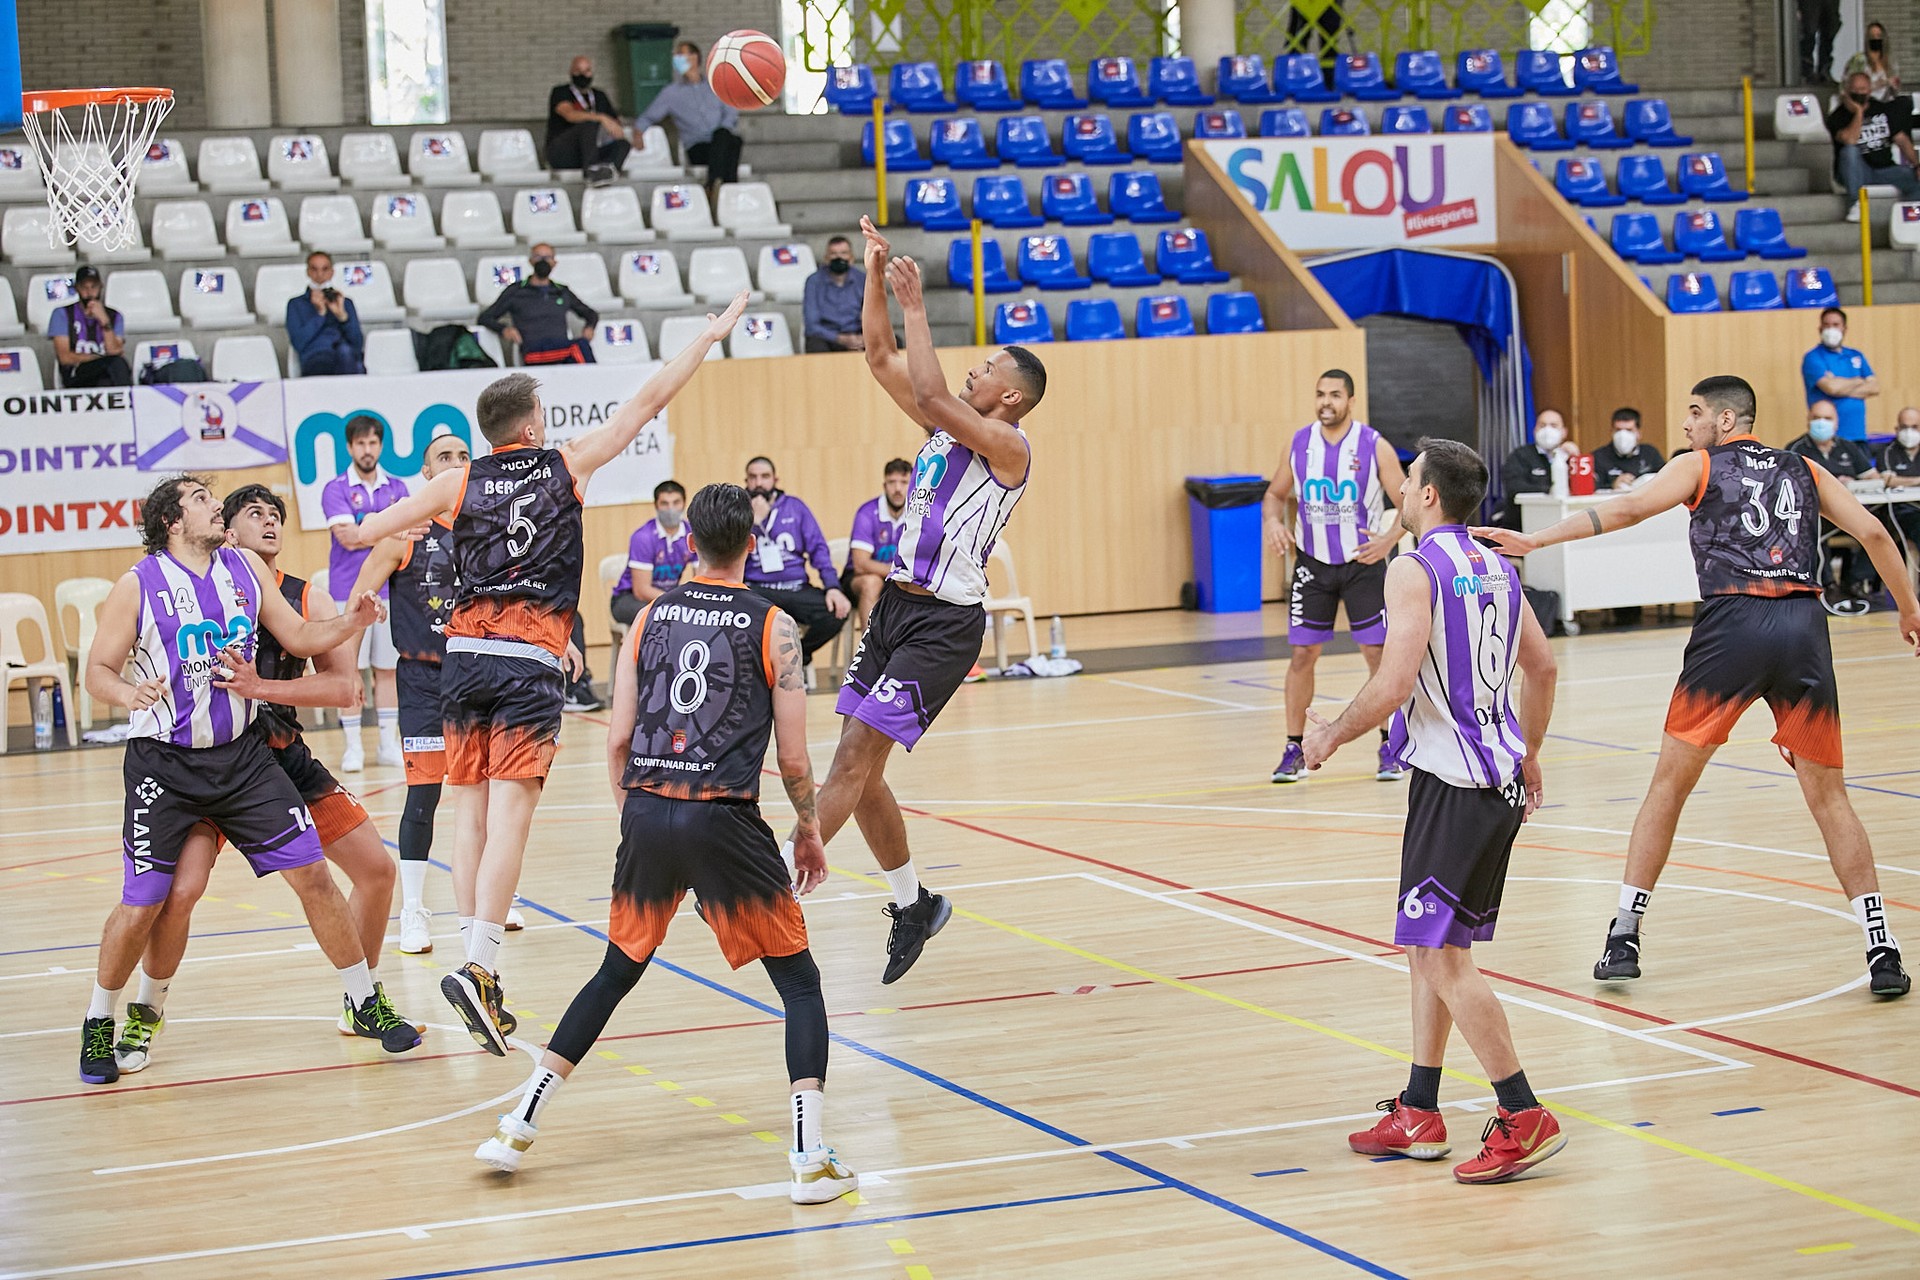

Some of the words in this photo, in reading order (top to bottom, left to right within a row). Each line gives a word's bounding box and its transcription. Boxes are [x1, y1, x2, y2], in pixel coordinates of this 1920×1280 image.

[1227, 144, 1445, 216] SALOU
[506, 492, 538, 558] 5
[1741, 477, 1802, 538] 34
[157, 587, 195, 617] 14
[653, 604, 752, 629] NAVARRO
[1291, 582, 1304, 627] LANA
[669, 639, 711, 715] 8
[1477, 601, 1506, 693] 6
[634, 757, 684, 770] QUINTANAR
[685, 762, 701, 772] DEL
[133, 808, 153, 876] LANA
[1403, 886, 1424, 919] 6
